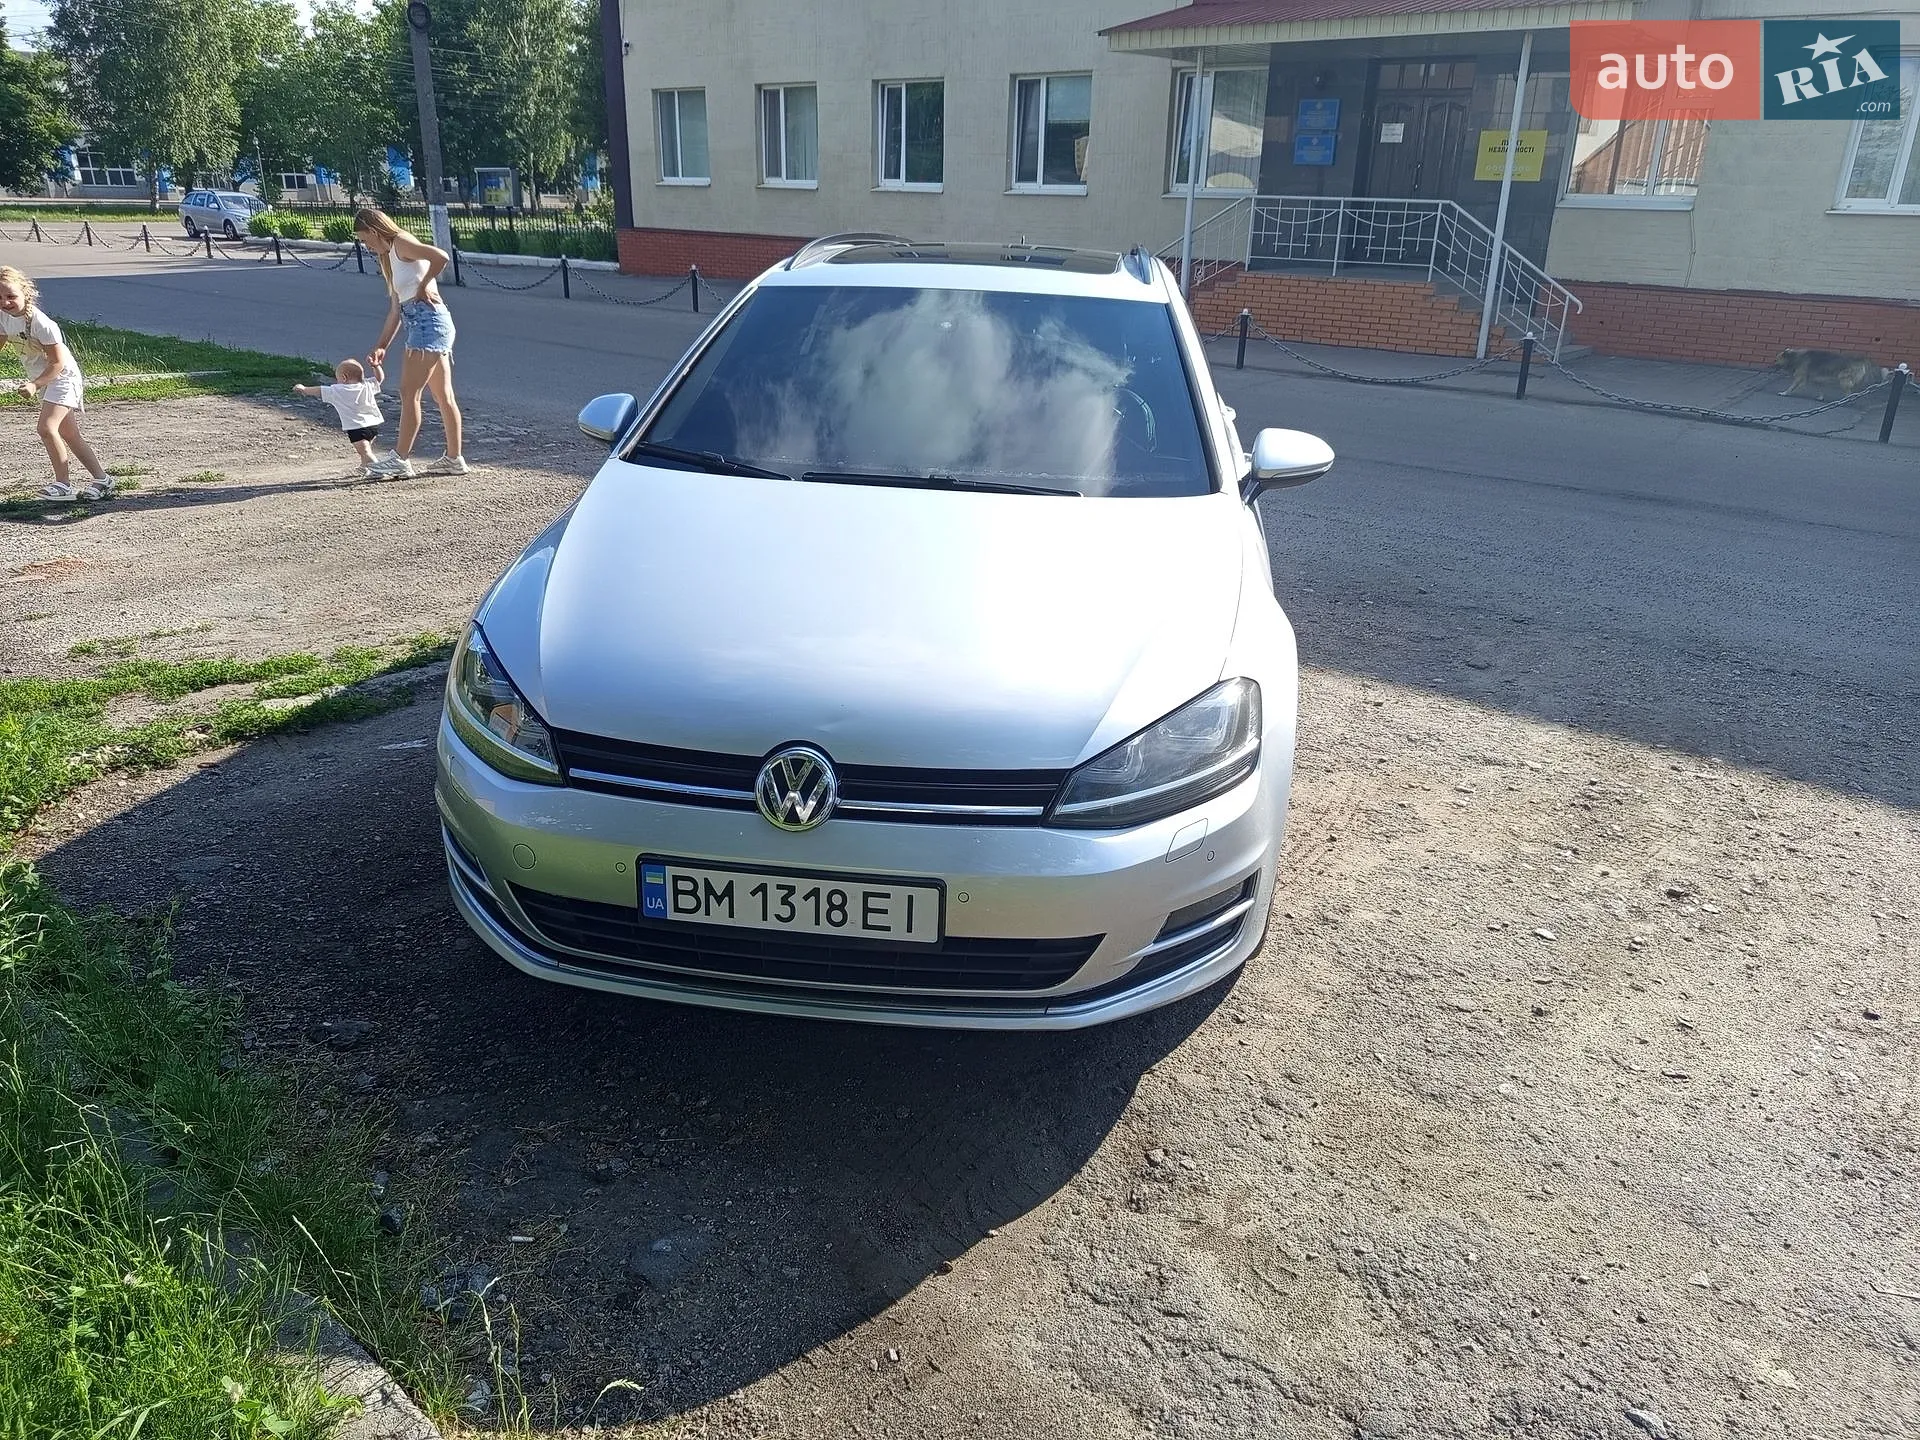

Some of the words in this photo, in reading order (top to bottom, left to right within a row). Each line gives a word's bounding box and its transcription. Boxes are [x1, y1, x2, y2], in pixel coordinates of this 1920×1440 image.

[647, 896, 665, 910] UA
[671, 874, 735, 919] BM
[749, 882, 849, 928] 1318
[861, 891, 914, 933] EI
